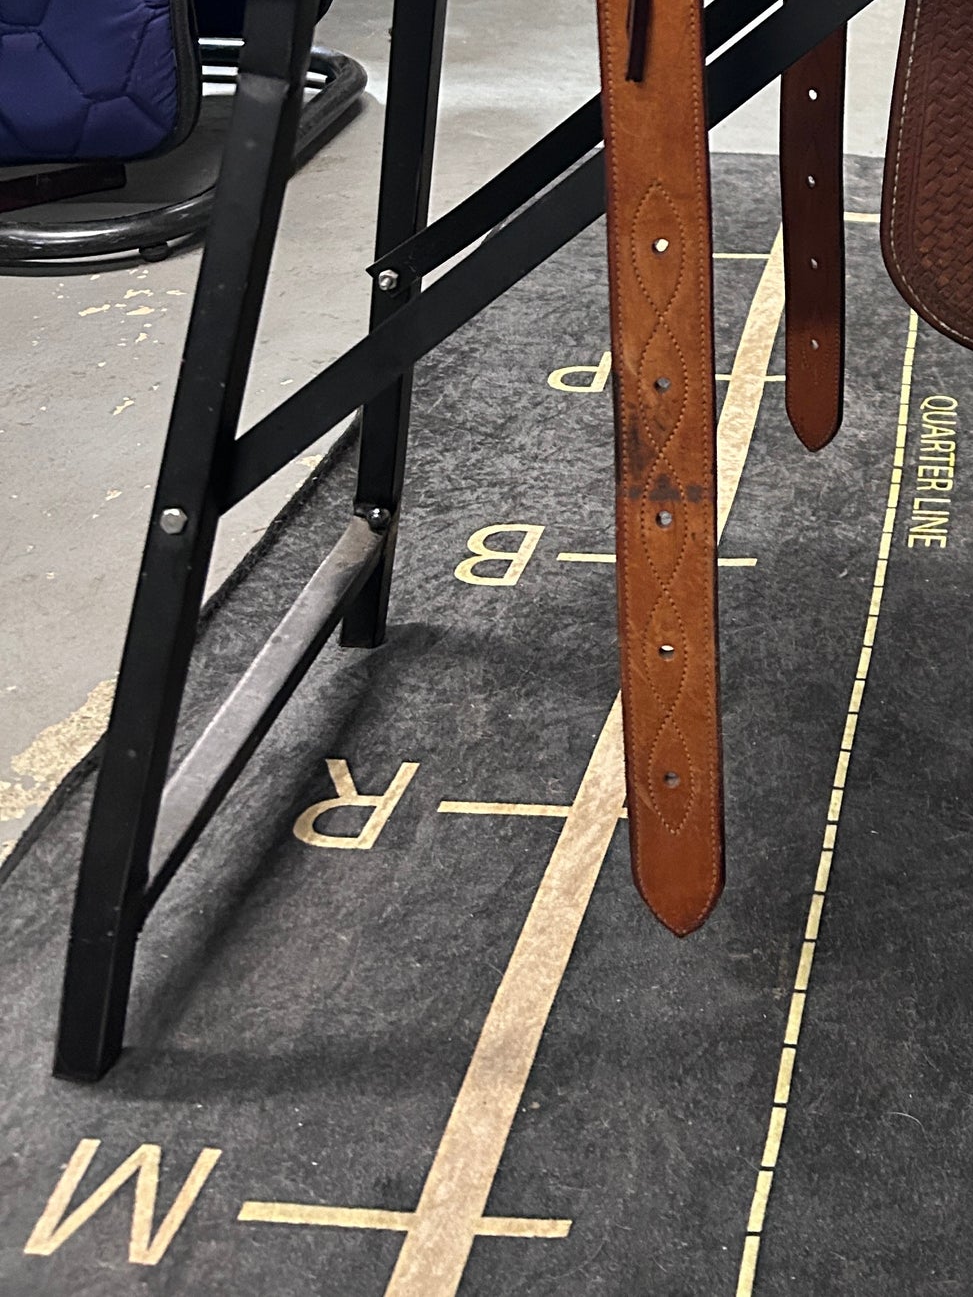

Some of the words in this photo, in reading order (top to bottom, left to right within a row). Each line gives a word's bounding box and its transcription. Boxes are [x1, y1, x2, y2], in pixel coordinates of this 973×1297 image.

[548, 351, 612, 393] P
[916, 395, 959, 492] QUARTER
[454, 524, 546, 586] B
[907, 498, 952, 549] LINE
[293, 759, 420, 849] R
[24, 1139, 222, 1265] M
